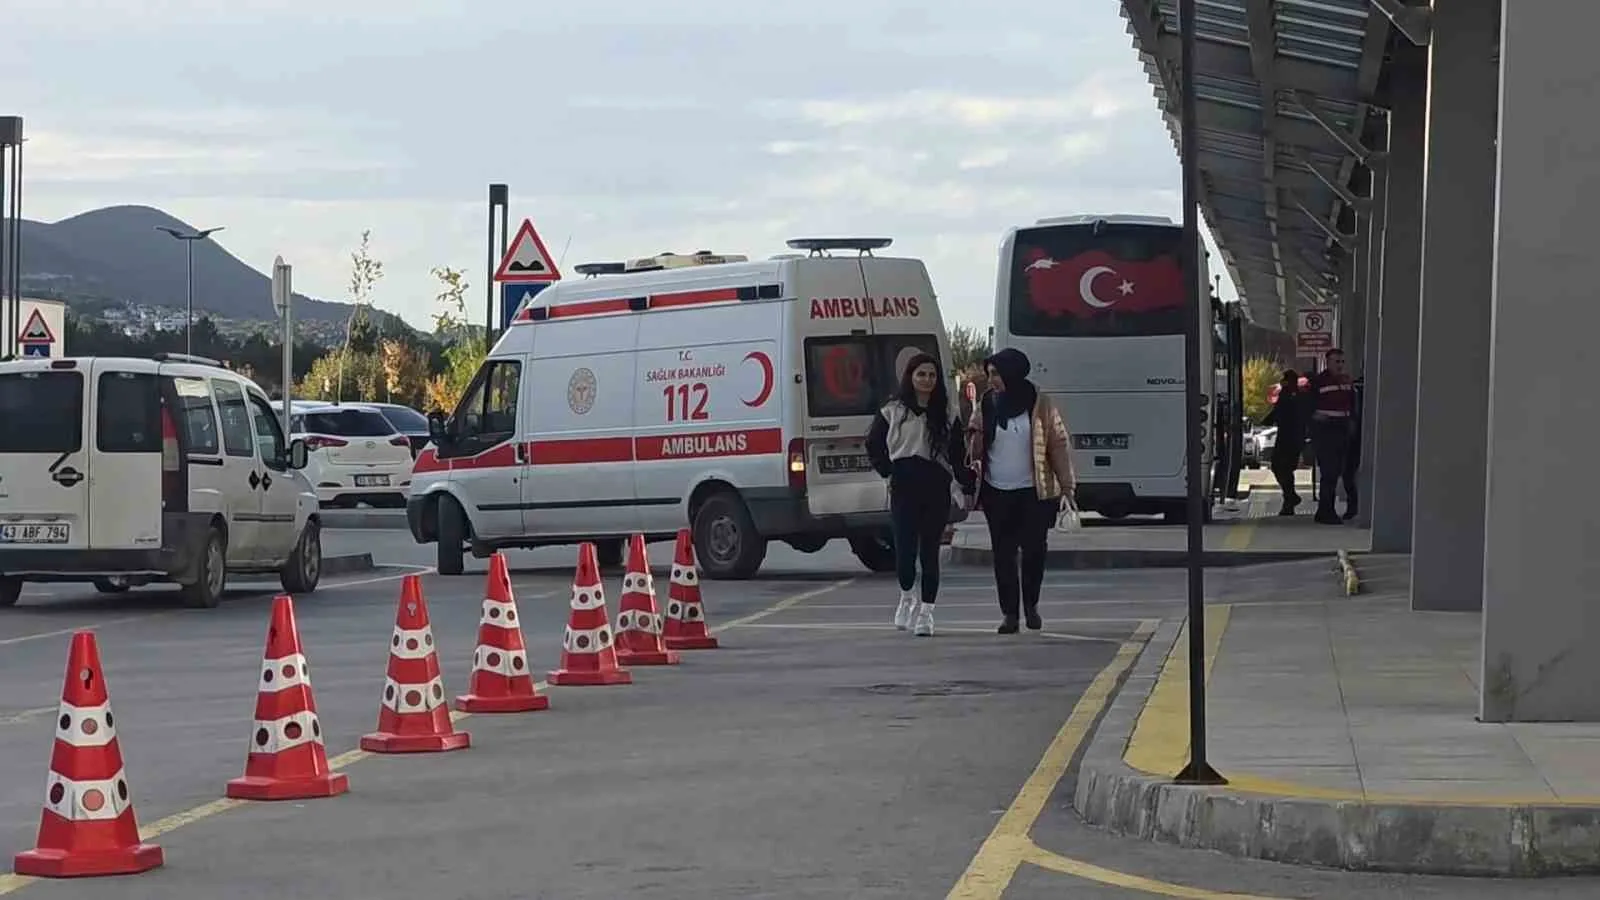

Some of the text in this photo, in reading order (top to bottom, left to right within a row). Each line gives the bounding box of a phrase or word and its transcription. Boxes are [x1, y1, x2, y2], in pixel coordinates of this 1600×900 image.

[809, 297, 920, 319] AMBULANS
[646, 367, 677, 382] SAĞLIK
[663, 382, 709, 422] 112
[661, 434, 748, 455] AMBULANS
[3, 526, 66, 538] 43 ABF 794
